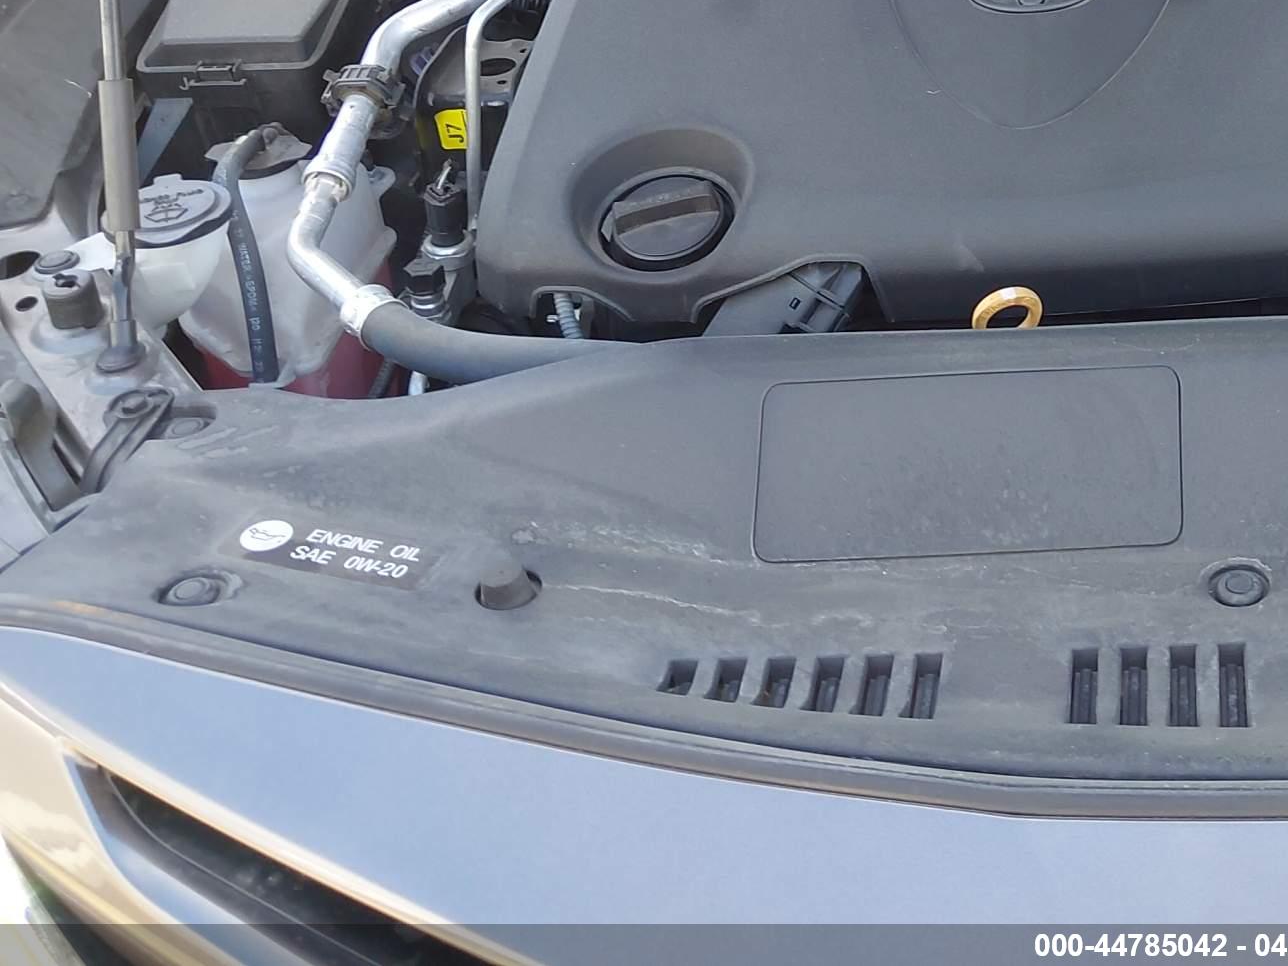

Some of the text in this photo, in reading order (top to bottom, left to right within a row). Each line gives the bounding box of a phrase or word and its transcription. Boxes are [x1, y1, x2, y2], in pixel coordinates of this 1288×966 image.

[445, 123, 464, 143] J7
[290, 545, 409, 579] SAE 0W-20
[305, 529, 420, 562] ENGINE OIL
